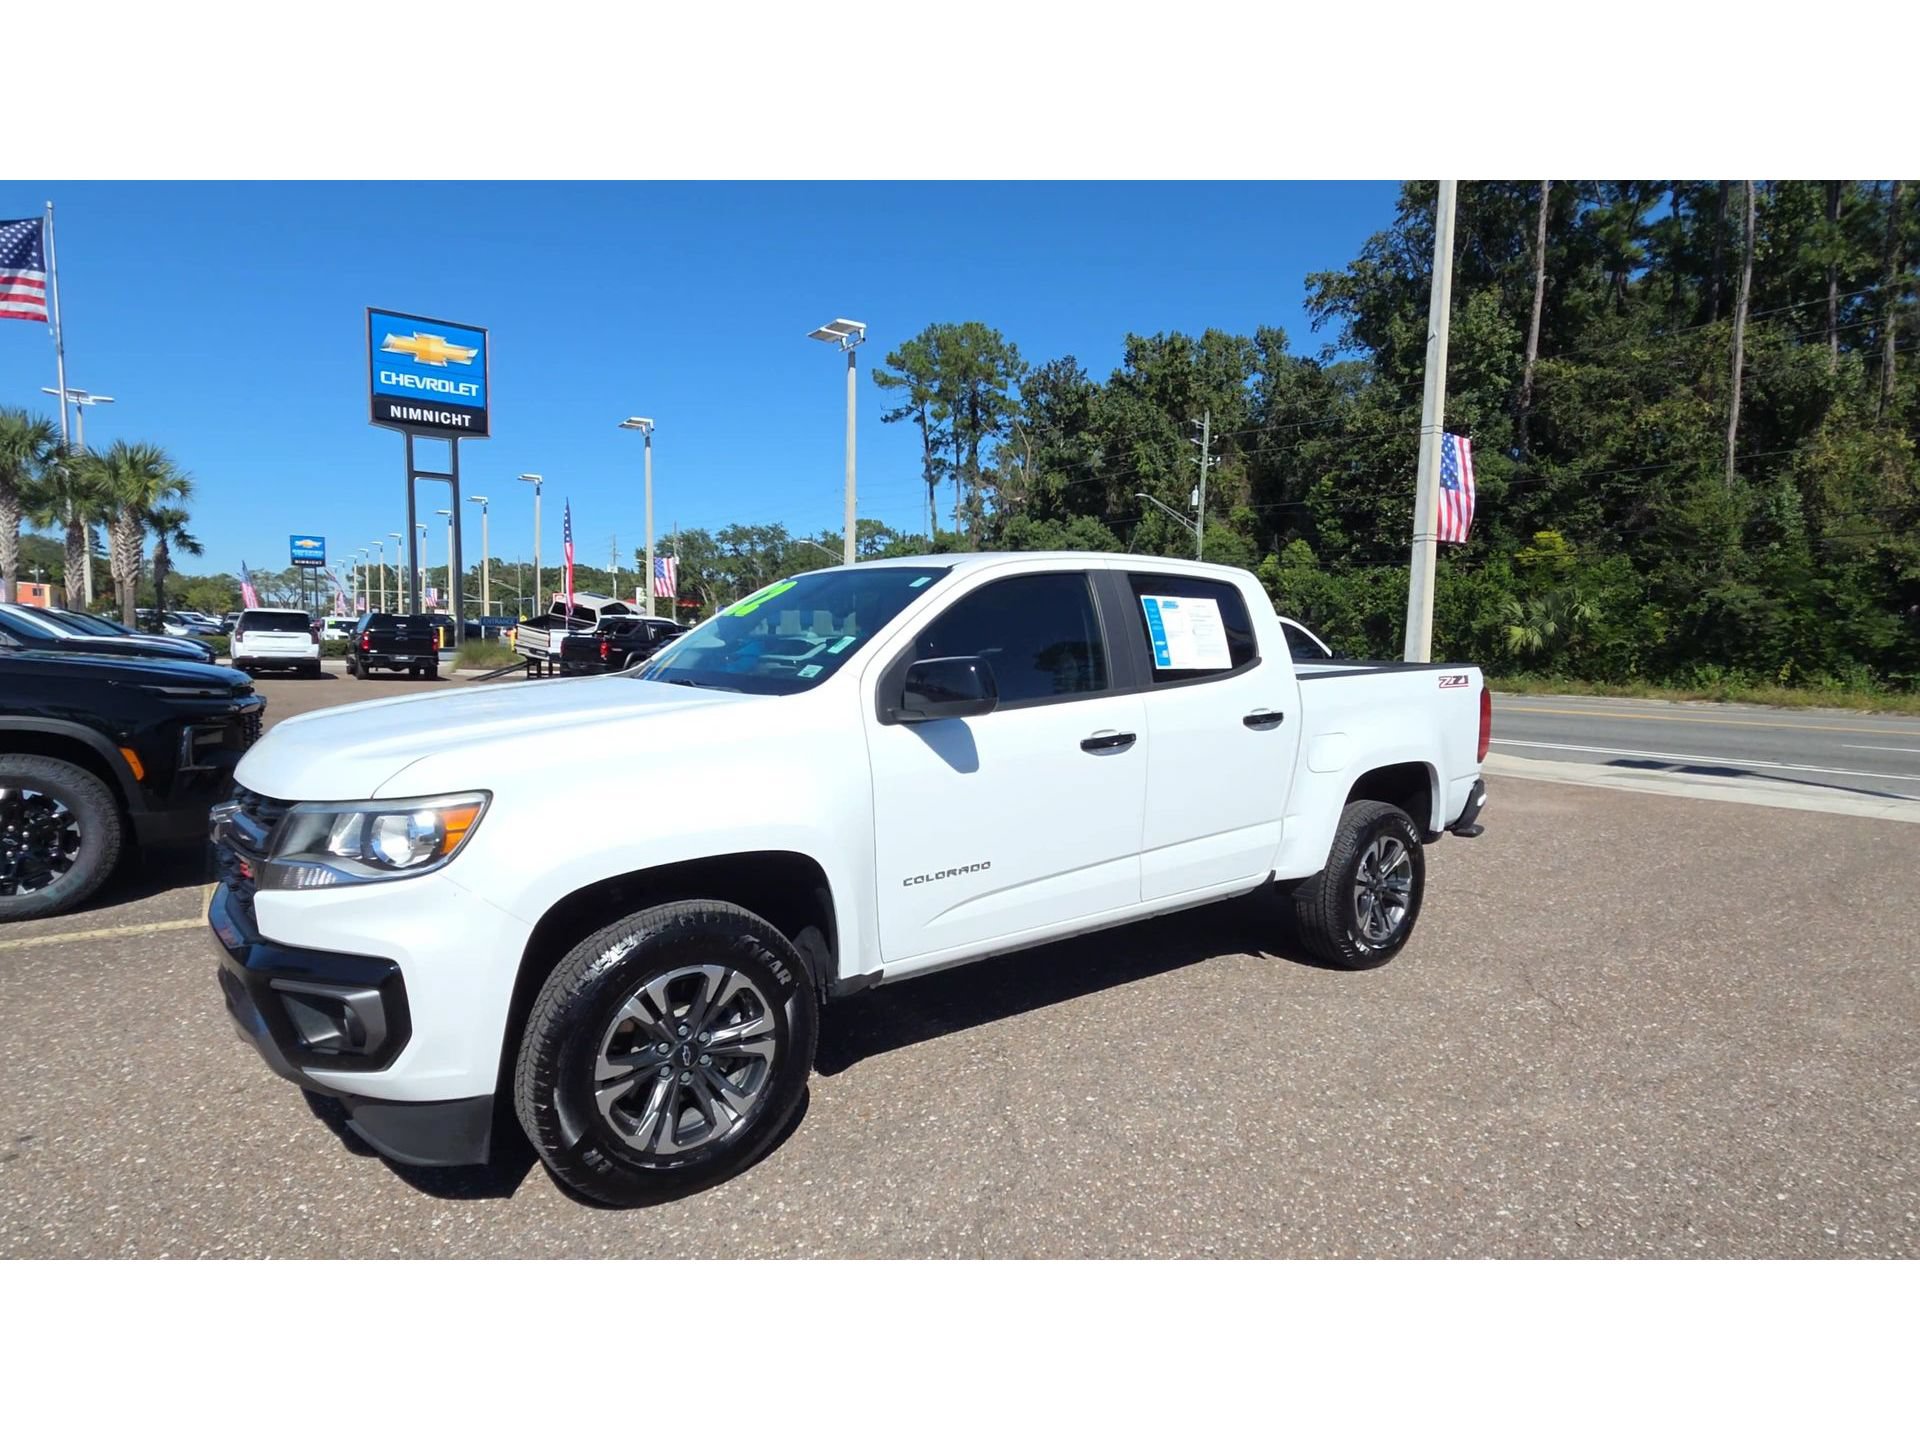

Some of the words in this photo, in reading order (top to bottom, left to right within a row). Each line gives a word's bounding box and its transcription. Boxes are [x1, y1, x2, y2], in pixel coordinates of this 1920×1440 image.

[380, 370, 479, 397] CHEVROLET
[390, 405, 472, 427] NIMNICHT
[902, 861, 991, 887] COLORADO
